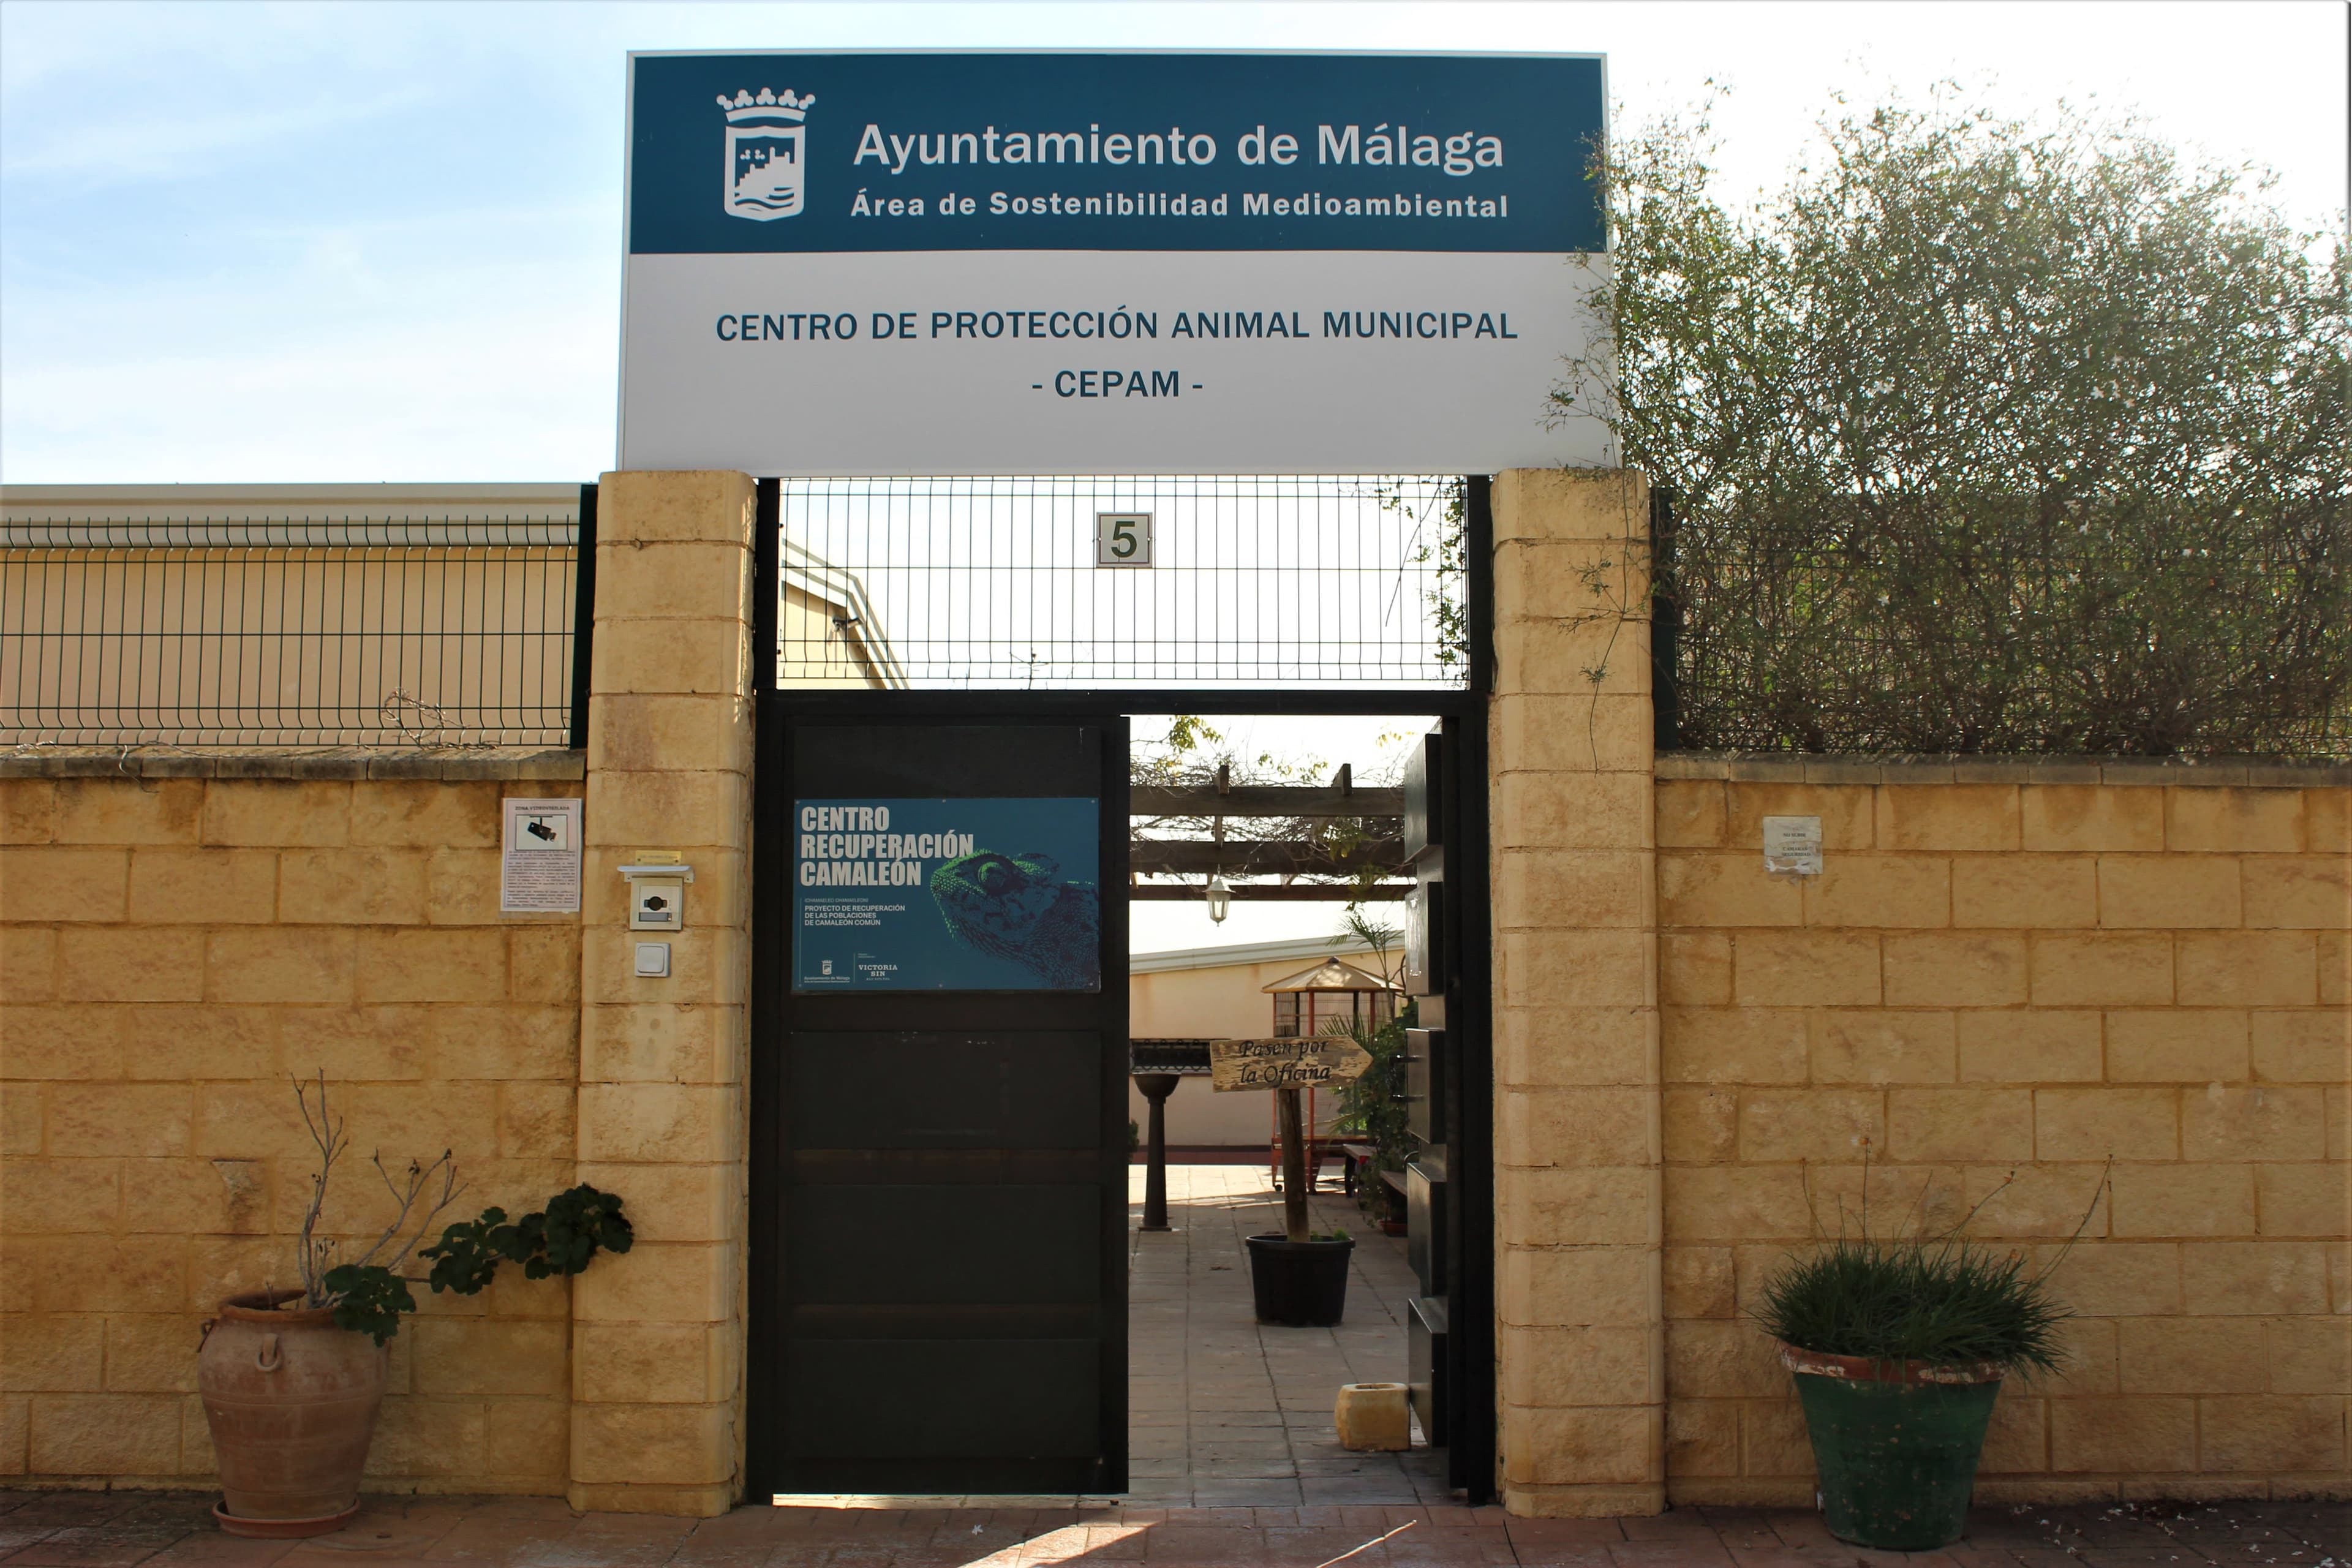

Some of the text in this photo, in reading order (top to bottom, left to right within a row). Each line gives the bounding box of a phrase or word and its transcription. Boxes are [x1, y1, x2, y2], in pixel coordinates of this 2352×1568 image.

[853, 123, 1503, 176] Ayuntamiento de Málaga
[851, 187, 1507, 217] Área de Sostenibilidad Medioambiental
[717, 304, 1518, 341] CENTRO DE PROTECCIÓN ANIMAL MUNICIPAL
[1055, 370, 1179, 398] CEPAM
[1110, 521, 1137, 558] 5
[801, 807, 889, 832] CENTRO
[801, 829, 974, 859] RECUPERACIÓN
[800, 858, 921, 886] CAMALEÓN
[1239, 1041, 1328, 1061] Pasen por
[1240, 1061, 1330, 1088] la Oficina
